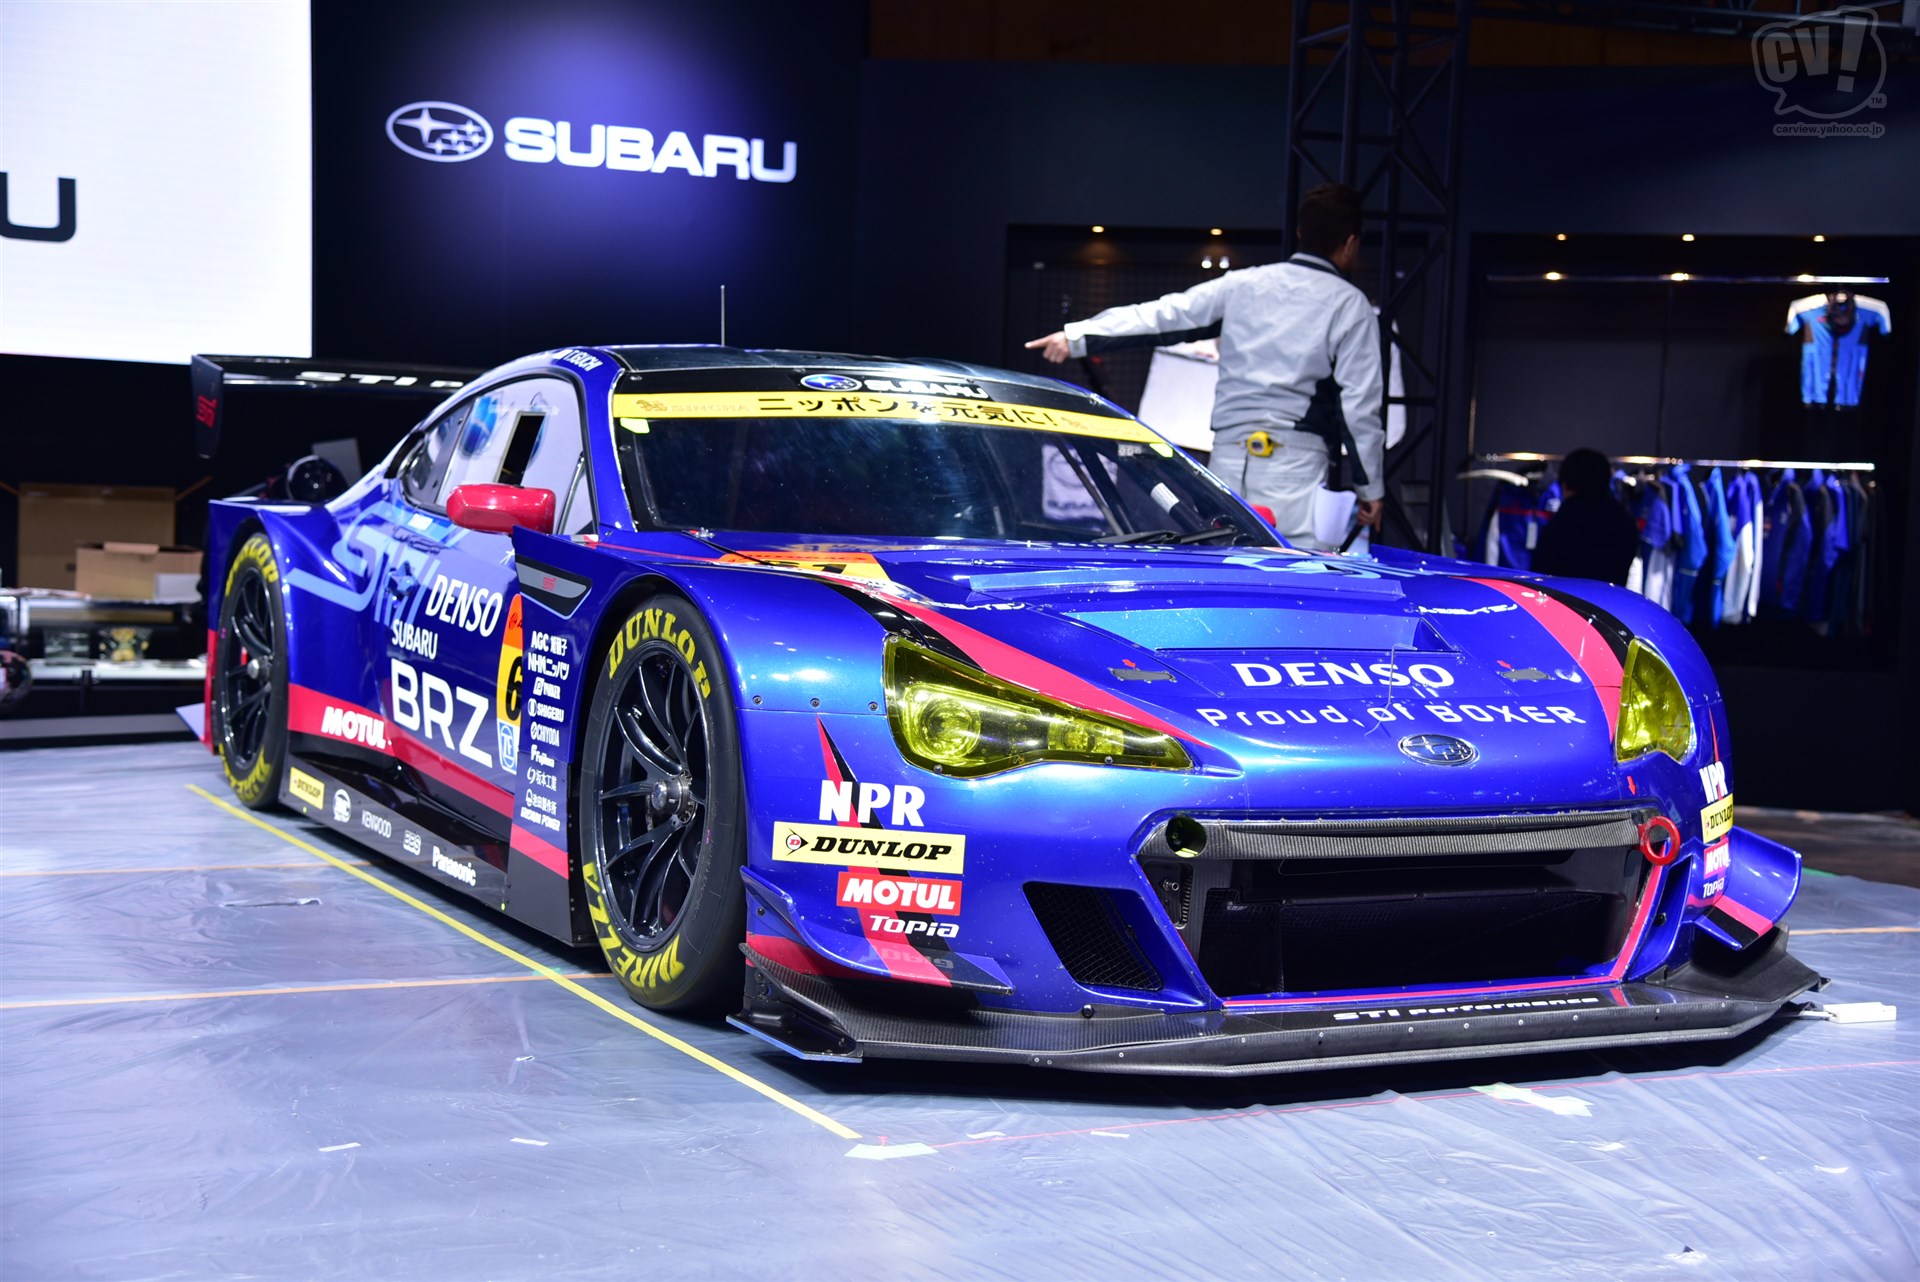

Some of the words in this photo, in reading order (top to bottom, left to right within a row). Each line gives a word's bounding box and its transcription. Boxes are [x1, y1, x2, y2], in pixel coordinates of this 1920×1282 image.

[504, 117, 798, 183] SUBARU
[864, 380, 989, 399] SUBARU
[425, 574, 504, 637] DENSO
[392, 619, 439, 660] SUBARU
[531, 630, 549, 652] AGC
[608, 608, 711, 699] DUNLOP
[1231, 662, 1456, 688] DENSO
[321, 706, 387, 749] MOTUL
[391, 658, 493, 768] BRZ
[1424, 704, 1587, 724] BOXER
[1699, 761, 1729, 803] NPR
[819, 780, 925, 827] NPR
[1710, 804, 1733, 829] DUNLOP
[361, 810, 392, 839] KENWOOD
[432, 846, 477, 887] Panasonic
[811, 836, 952, 860] DUNLOP
[842, 878, 956, 910] MOTUL
[583, 861, 685, 992] DIREZZA
[1333, 1008, 1400, 1021] STI
